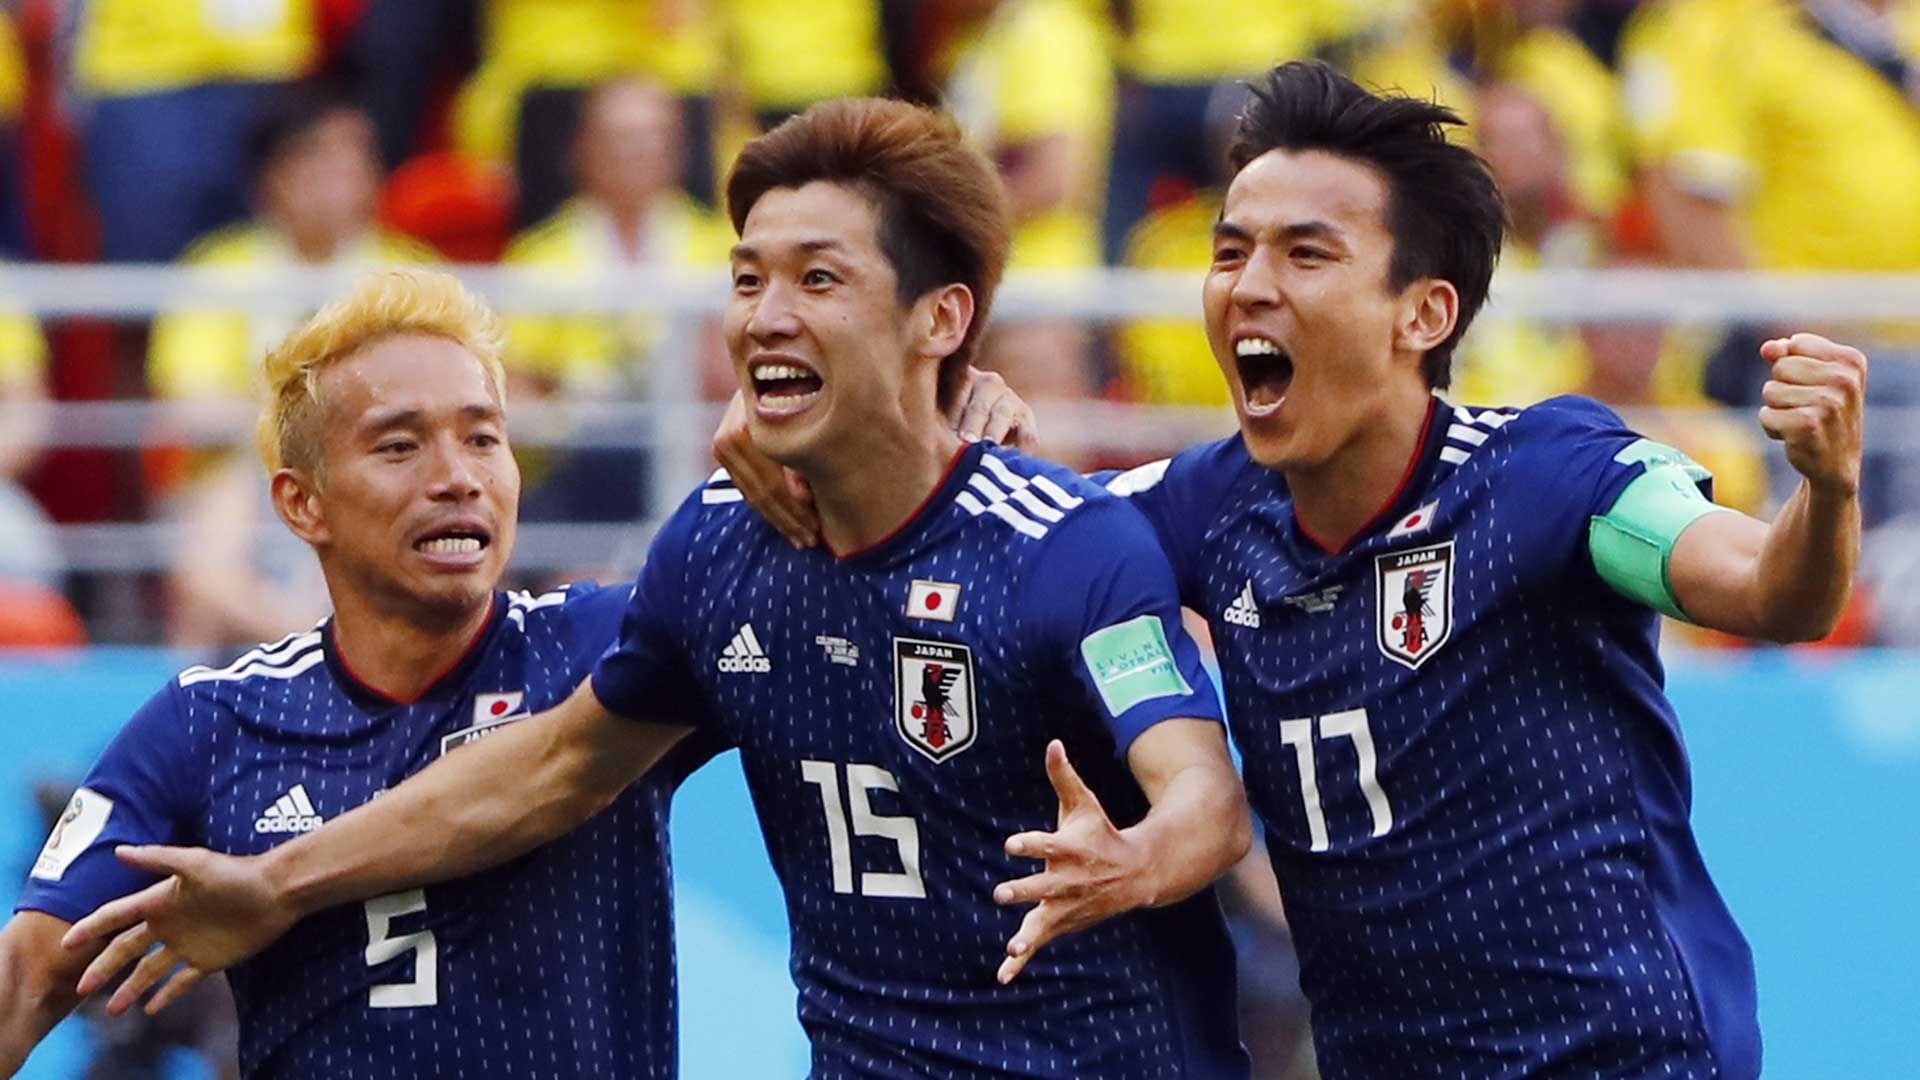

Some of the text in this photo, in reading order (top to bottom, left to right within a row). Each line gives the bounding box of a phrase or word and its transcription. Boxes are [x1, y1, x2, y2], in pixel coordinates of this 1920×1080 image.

[1396, 550, 1437, 568] JAPAN
[717, 654, 772, 673] adidas
[914, 644, 953, 659] JAPAN
[1279, 707, 1393, 853] 17
[800, 759, 927, 899] 15
[363, 887, 438, 1008] 5
